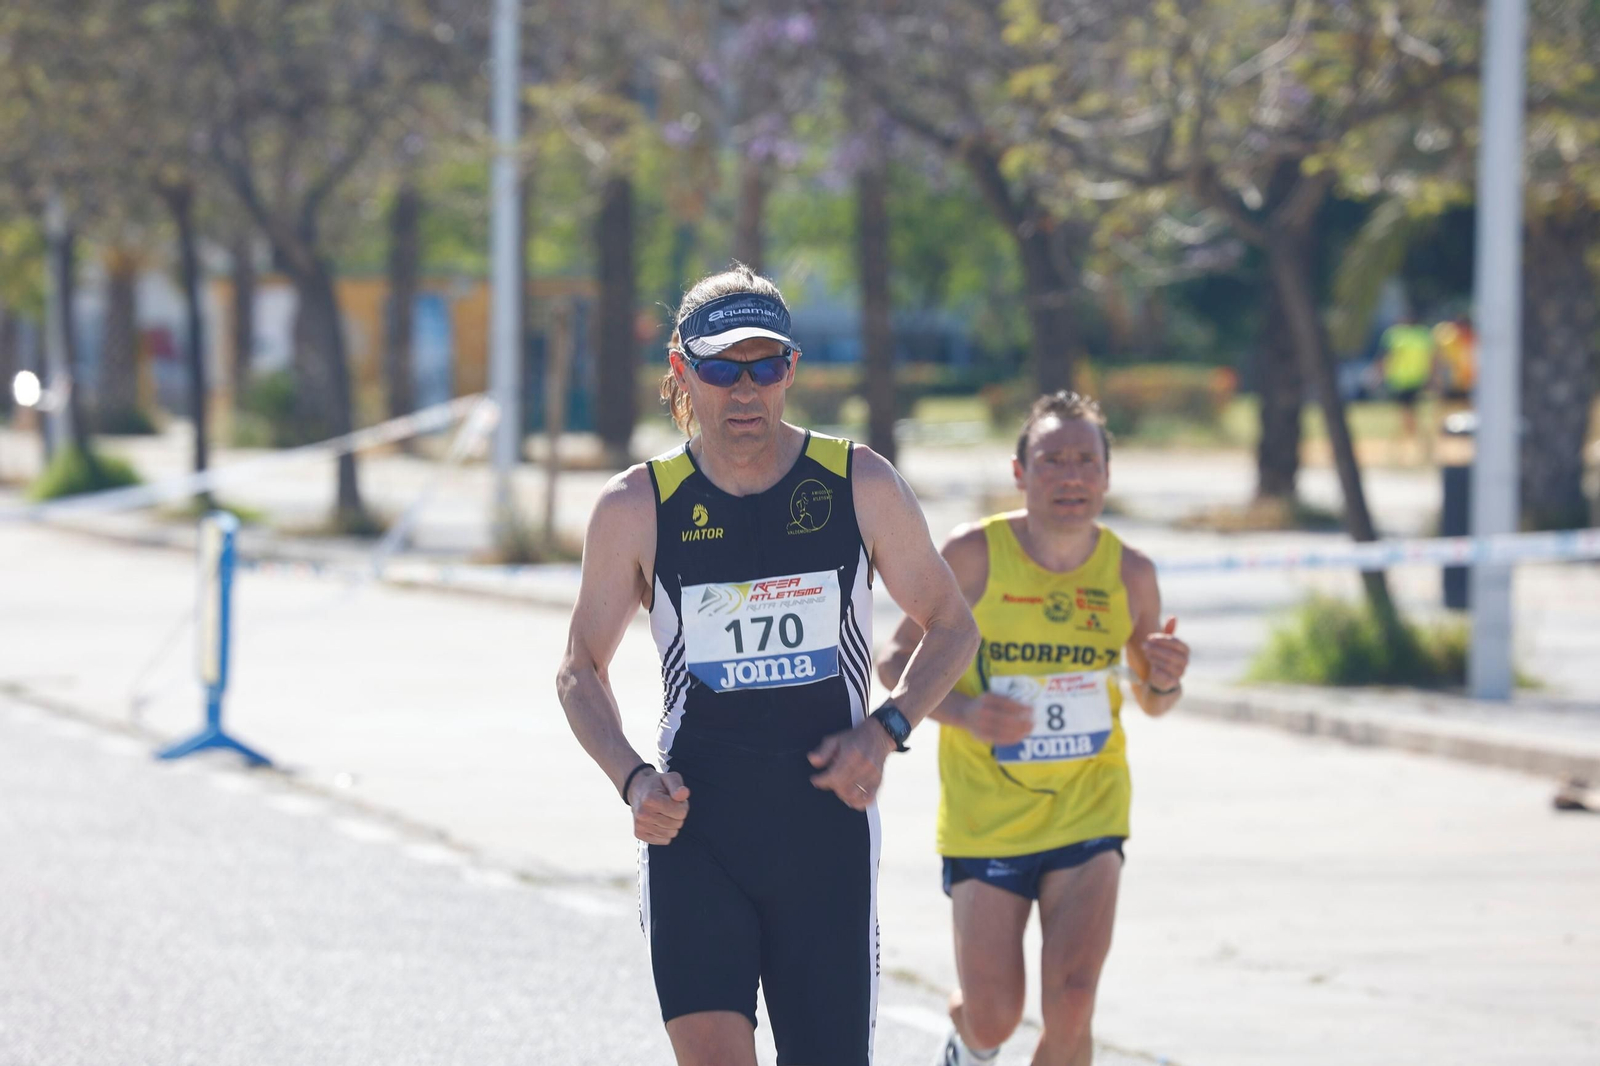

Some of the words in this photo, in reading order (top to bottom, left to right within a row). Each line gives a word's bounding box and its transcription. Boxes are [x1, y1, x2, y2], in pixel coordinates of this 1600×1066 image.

[681, 527, 724, 542] VIATOR
[753, 577, 801, 593] RFEA
[749, 586, 823, 602] ATLETISMO
[780, 596, 826, 608] RUNNING
[724, 612, 804, 654] 170
[1047, 704, 1065, 731] 8
